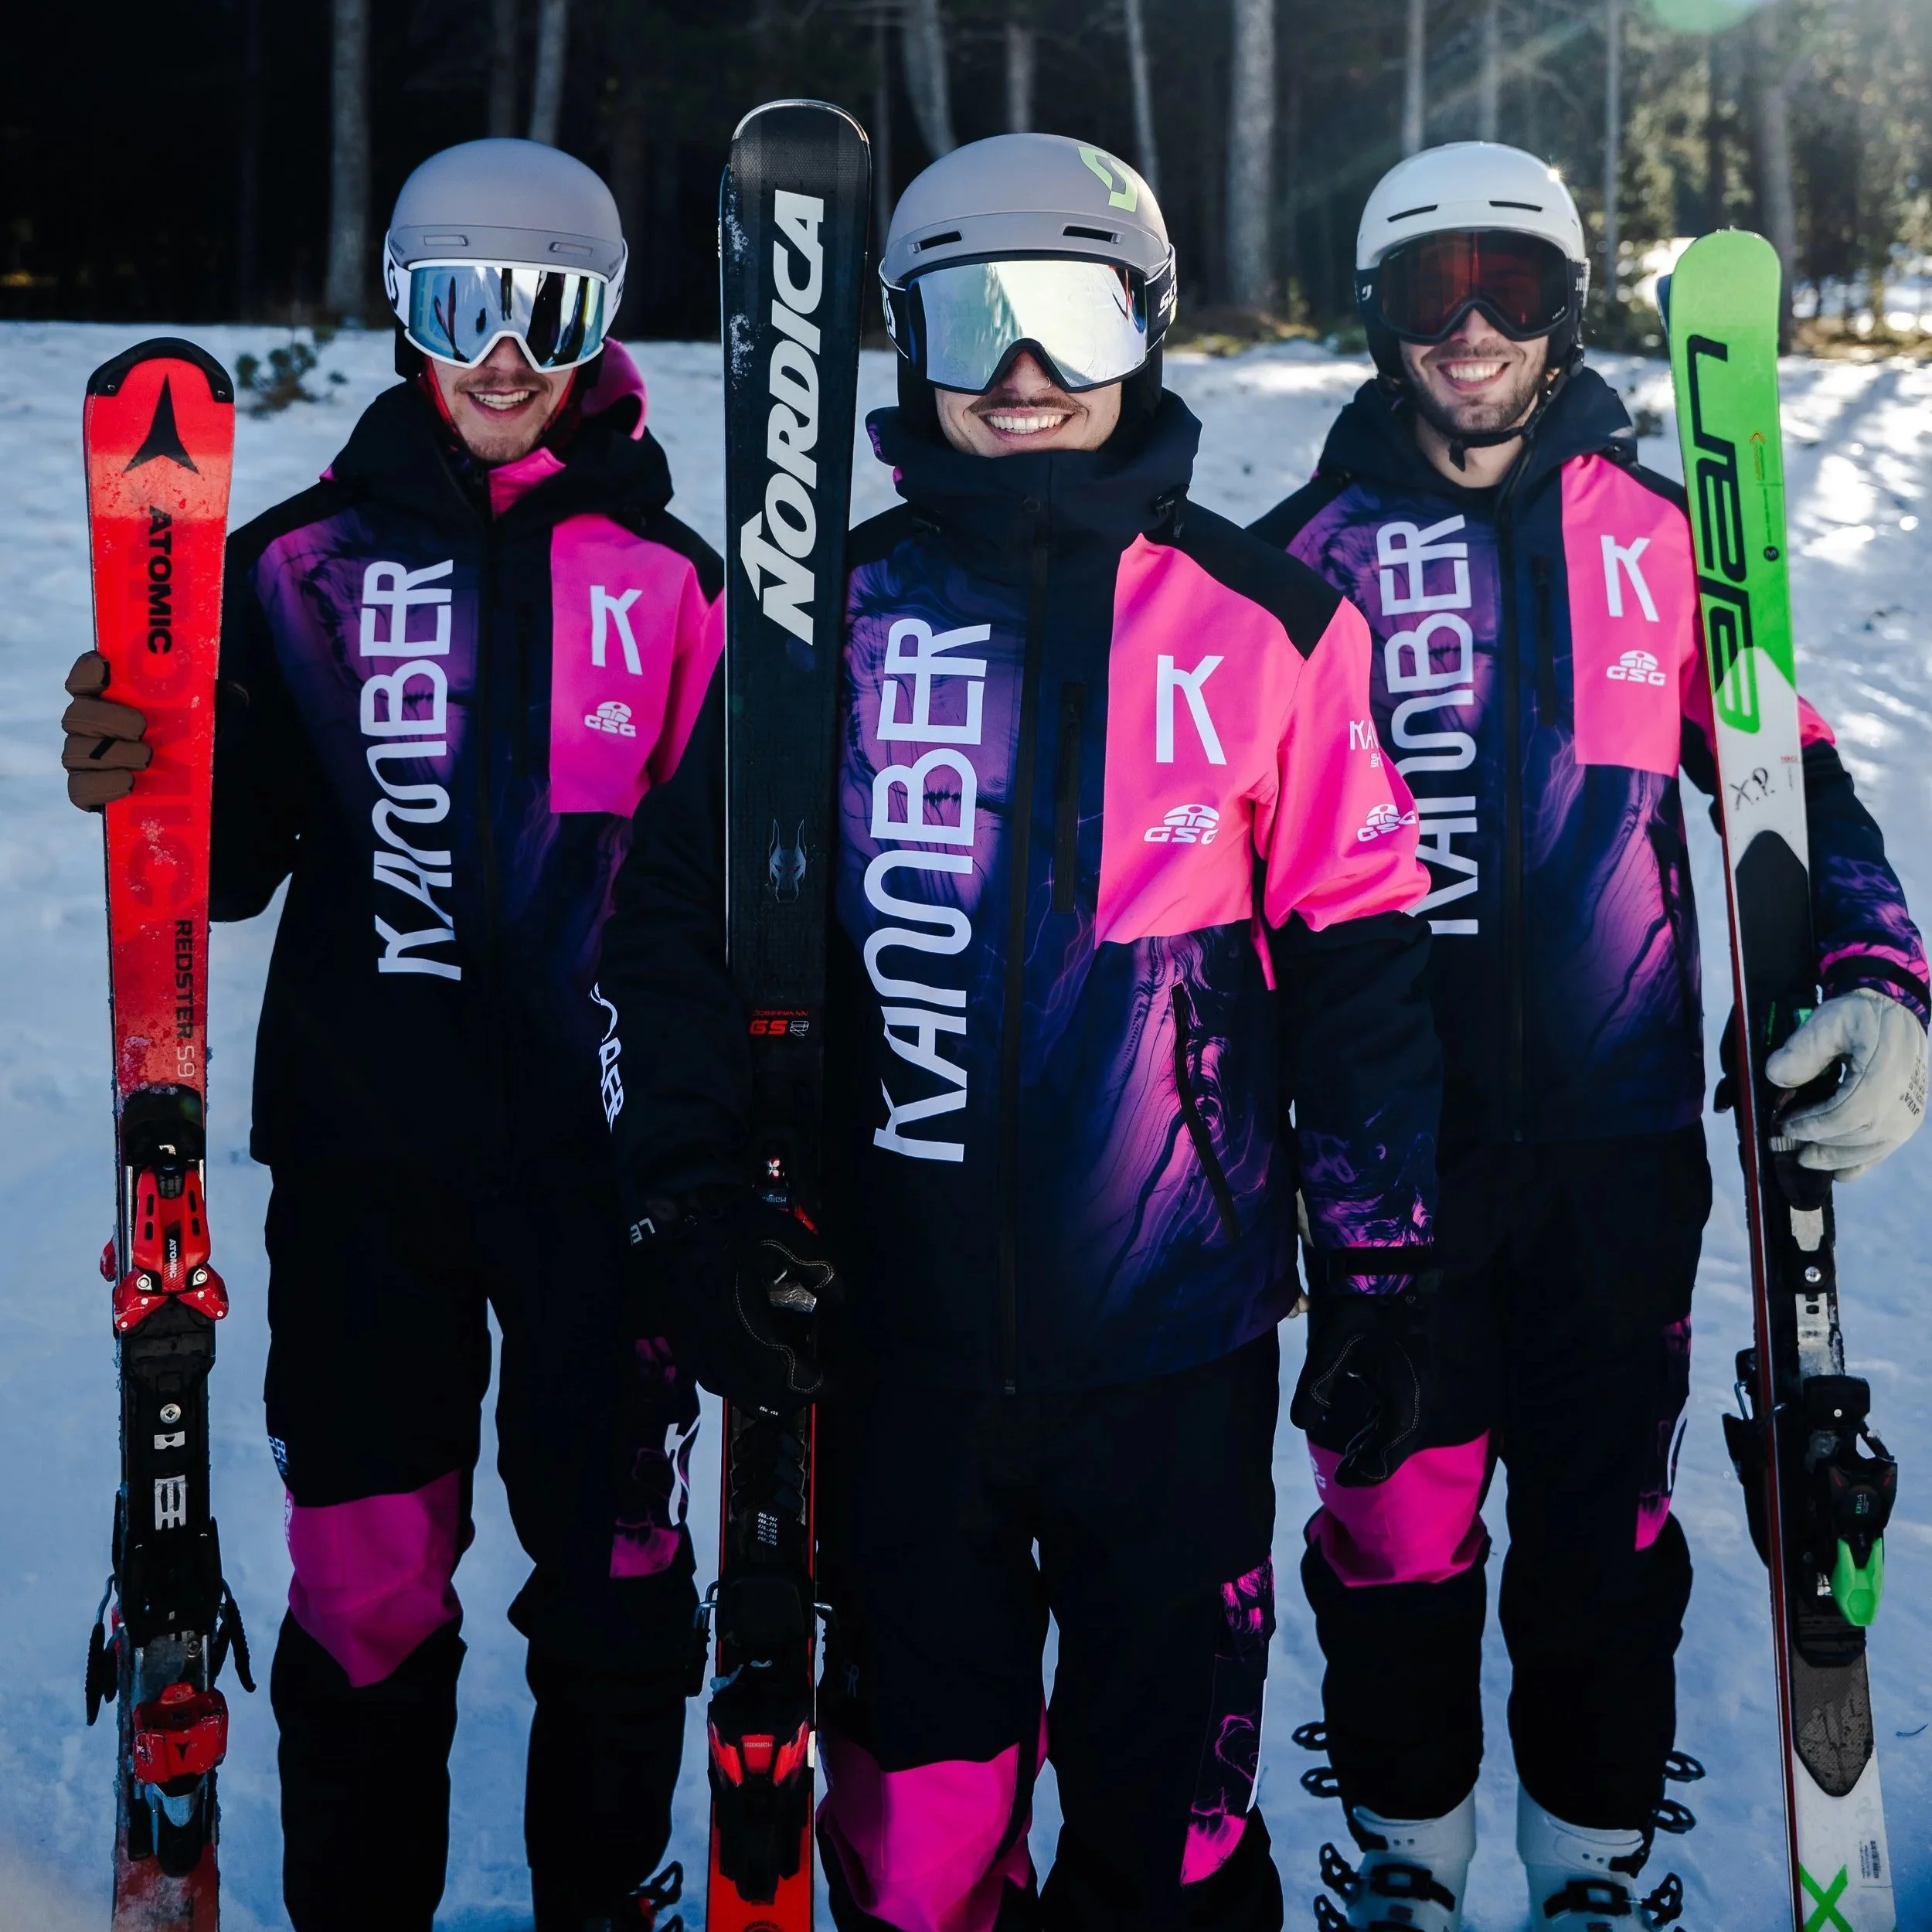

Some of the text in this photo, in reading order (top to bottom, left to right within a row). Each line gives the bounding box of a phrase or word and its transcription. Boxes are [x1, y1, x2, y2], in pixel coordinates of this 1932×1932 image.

[740, 190, 825, 646] NORDICA
[148, 505, 172, 654] ATOMIC
[1600, 535, 1659, 623] K
[1687, 335, 1761, 734] elan
[590, 585, 643, 675] K
[1606, 664, 1666, 687] GSG
[584, 714, 637, 737] GSG
[1155, 654, 1227, 765] K
[1376, 515, 1478, 934] KAMBER
[359, 560, 461, 981] KAMBER
[1356, 808, 1417, 842] GSG
[863, 617, 992, 1162] KAMBER
[1143, 826, 1219, 845] GSG
[175, 920, 196, 1078] REDSTER S9
[168, 1238, 178, 1279] ATOMIC
